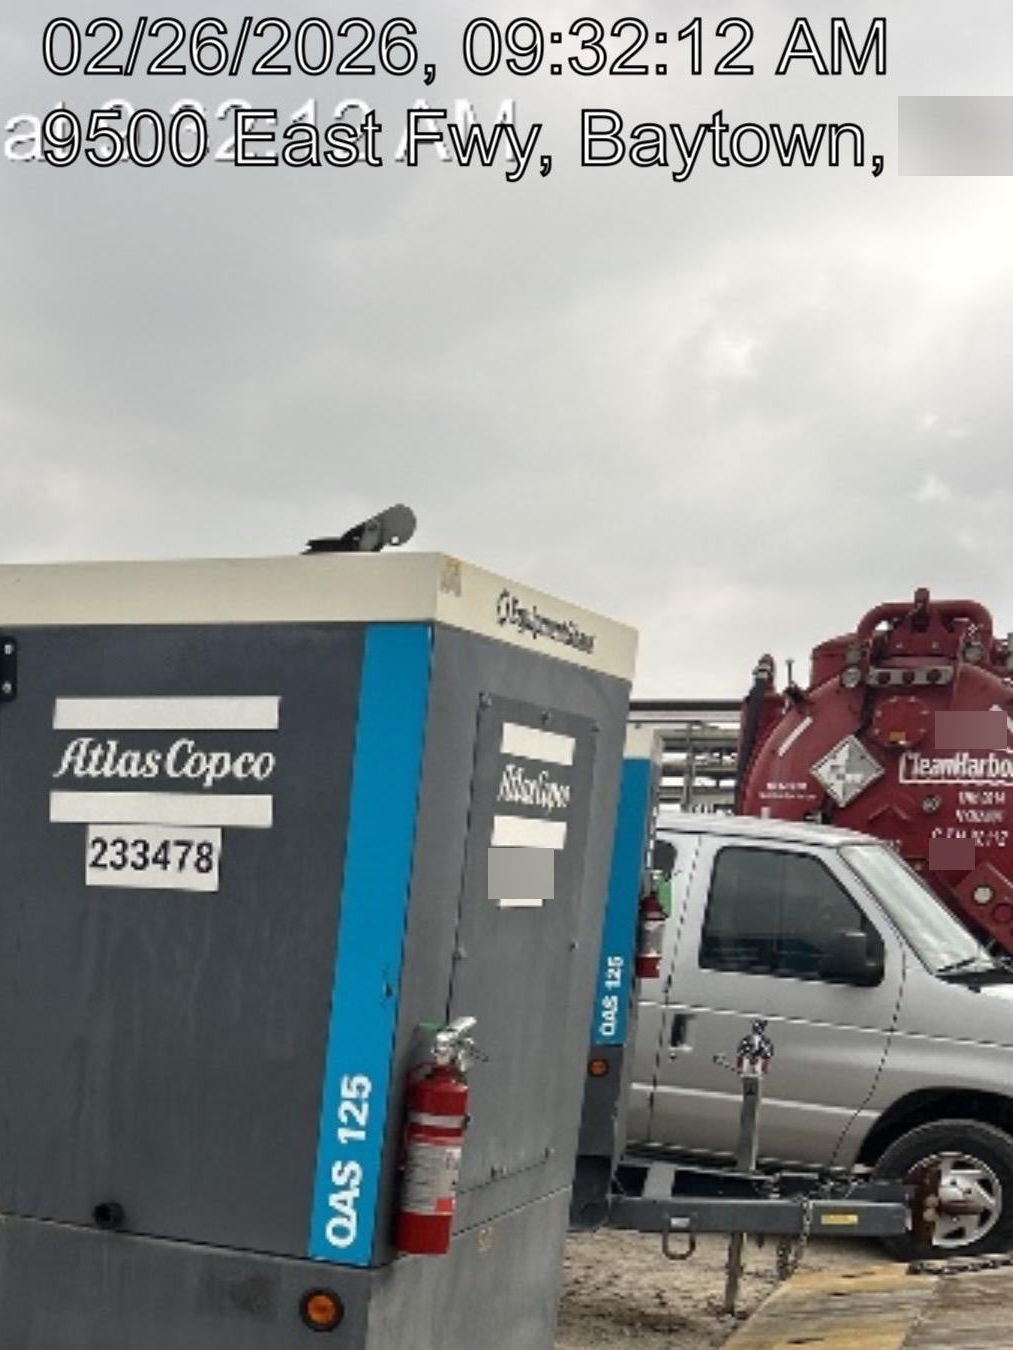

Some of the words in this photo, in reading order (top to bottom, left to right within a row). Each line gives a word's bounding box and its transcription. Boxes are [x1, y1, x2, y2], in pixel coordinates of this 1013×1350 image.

[53, 736, 162, 778] Atlas
[165, 737, 276, 788] Copco
[89, 836, 215, 874] 233478
[337, 1074, 372, 1144] 125
